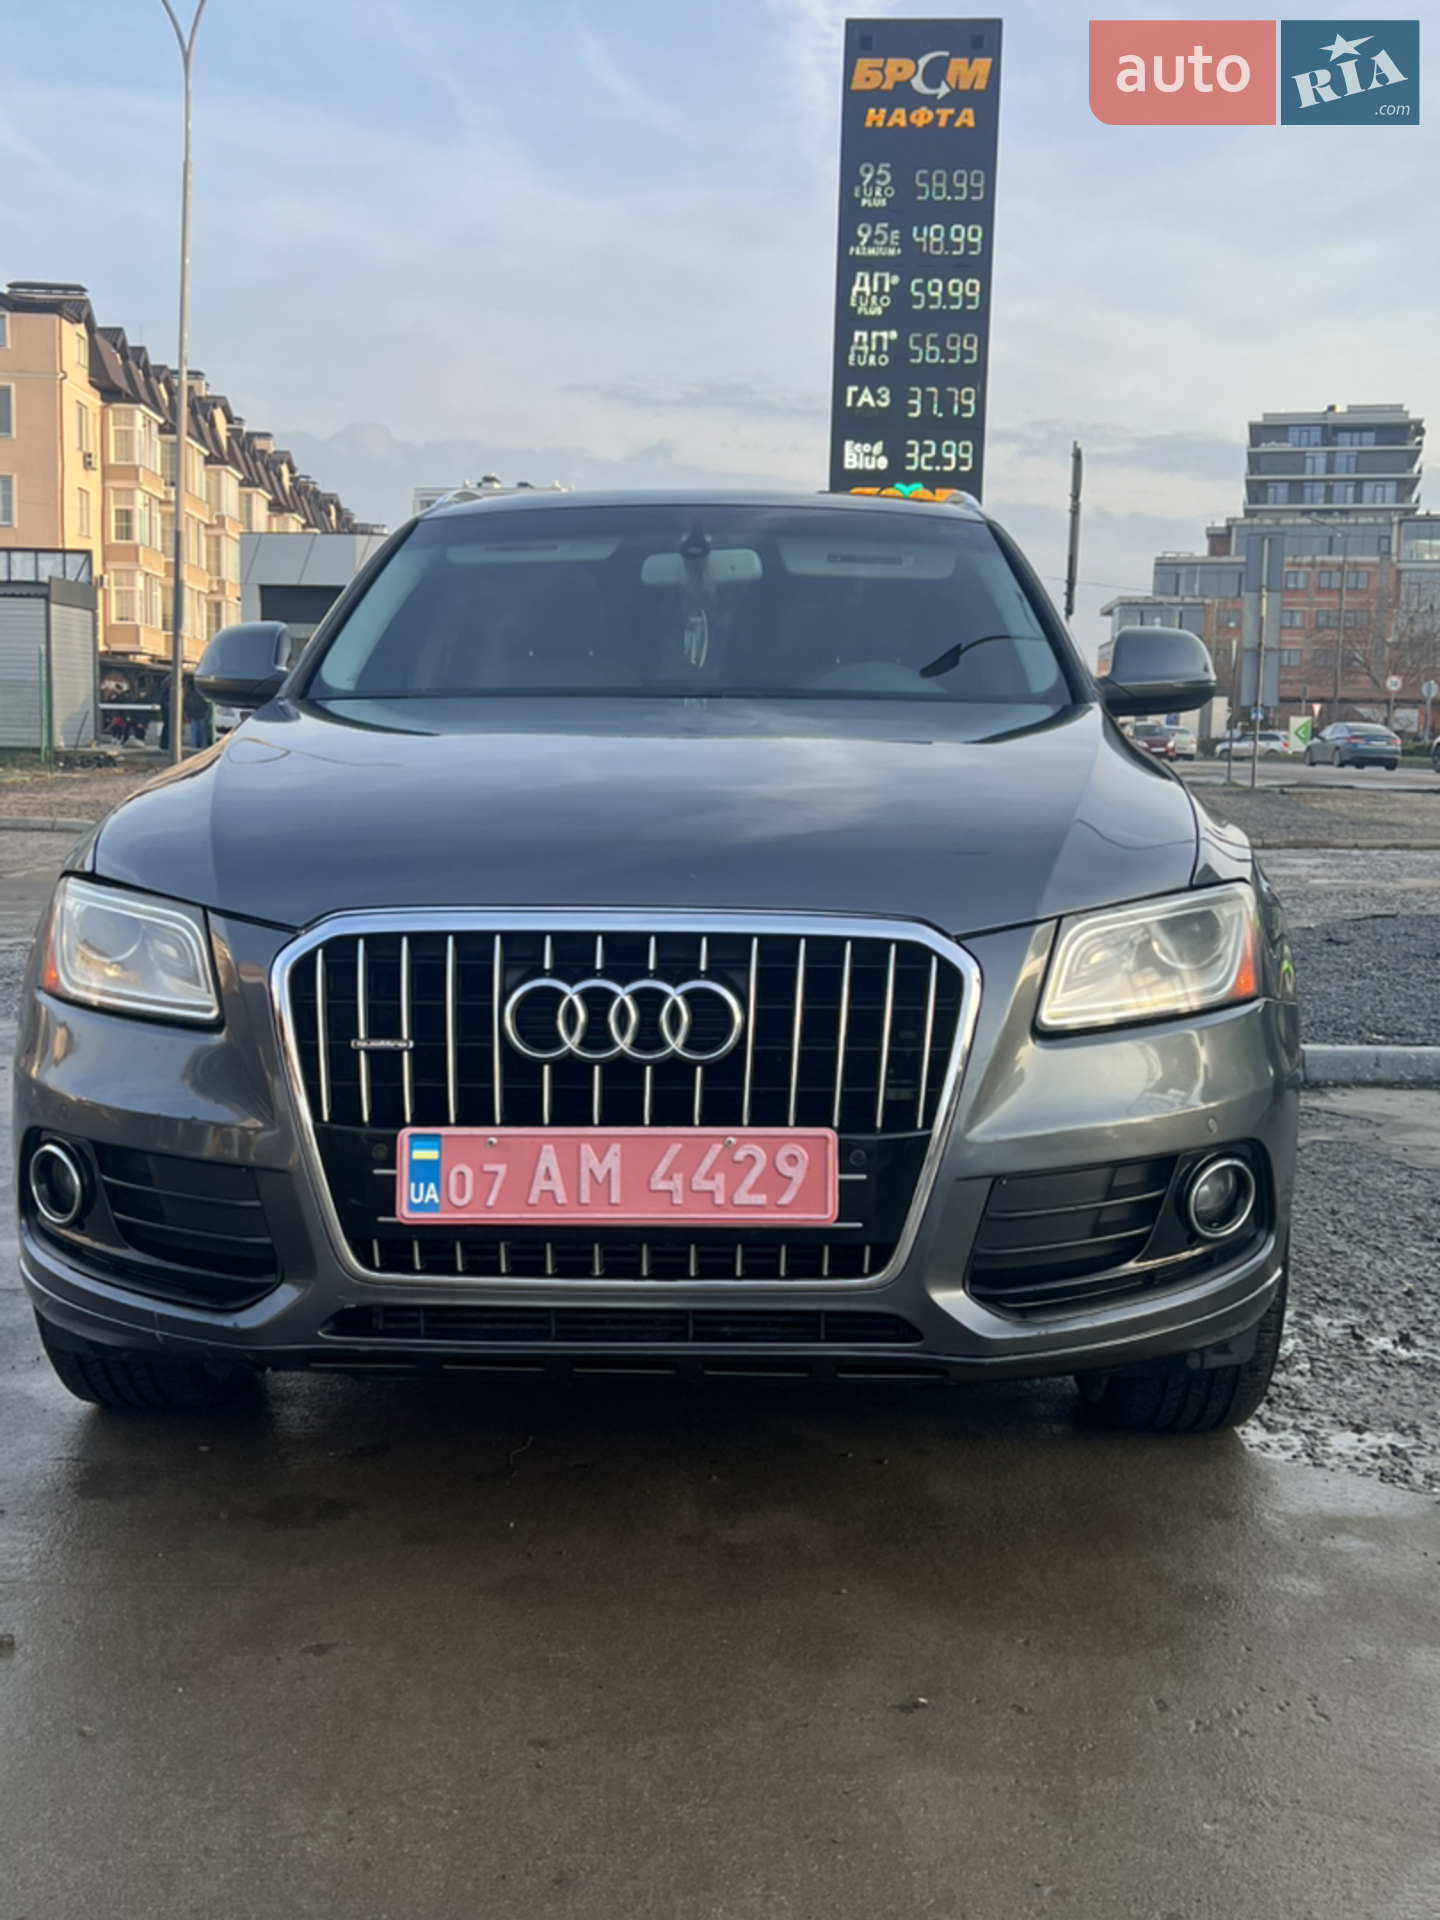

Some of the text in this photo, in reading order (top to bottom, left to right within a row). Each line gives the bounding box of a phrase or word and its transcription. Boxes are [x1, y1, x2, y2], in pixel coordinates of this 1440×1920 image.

[864, 107, 976, 129] НАФТА
[858, 162, 892, 187] 95
[915, 169, 985, 201] 58.99
[854, 186, 896, 198] EURO
[912, 224, 983, 256] 48.99
[849, 294, 892, 308] EURO
[910, 278, 981, 310] 59.99
[847, 353, 890, 367] EURO
[908, 333, 979, 364] 56.99
[846, 385, 891, 408] ГАЗ
[907, 387, 976, 418] 37.79
[844, 440, 872, 454] Eco
[905, 440, 973, 471] 32.99
[843, 453, 889, 470] Blue
[448, 1143, 809, 1209] 07 AM 4429
[409, 1182, 440, 1205] UA
